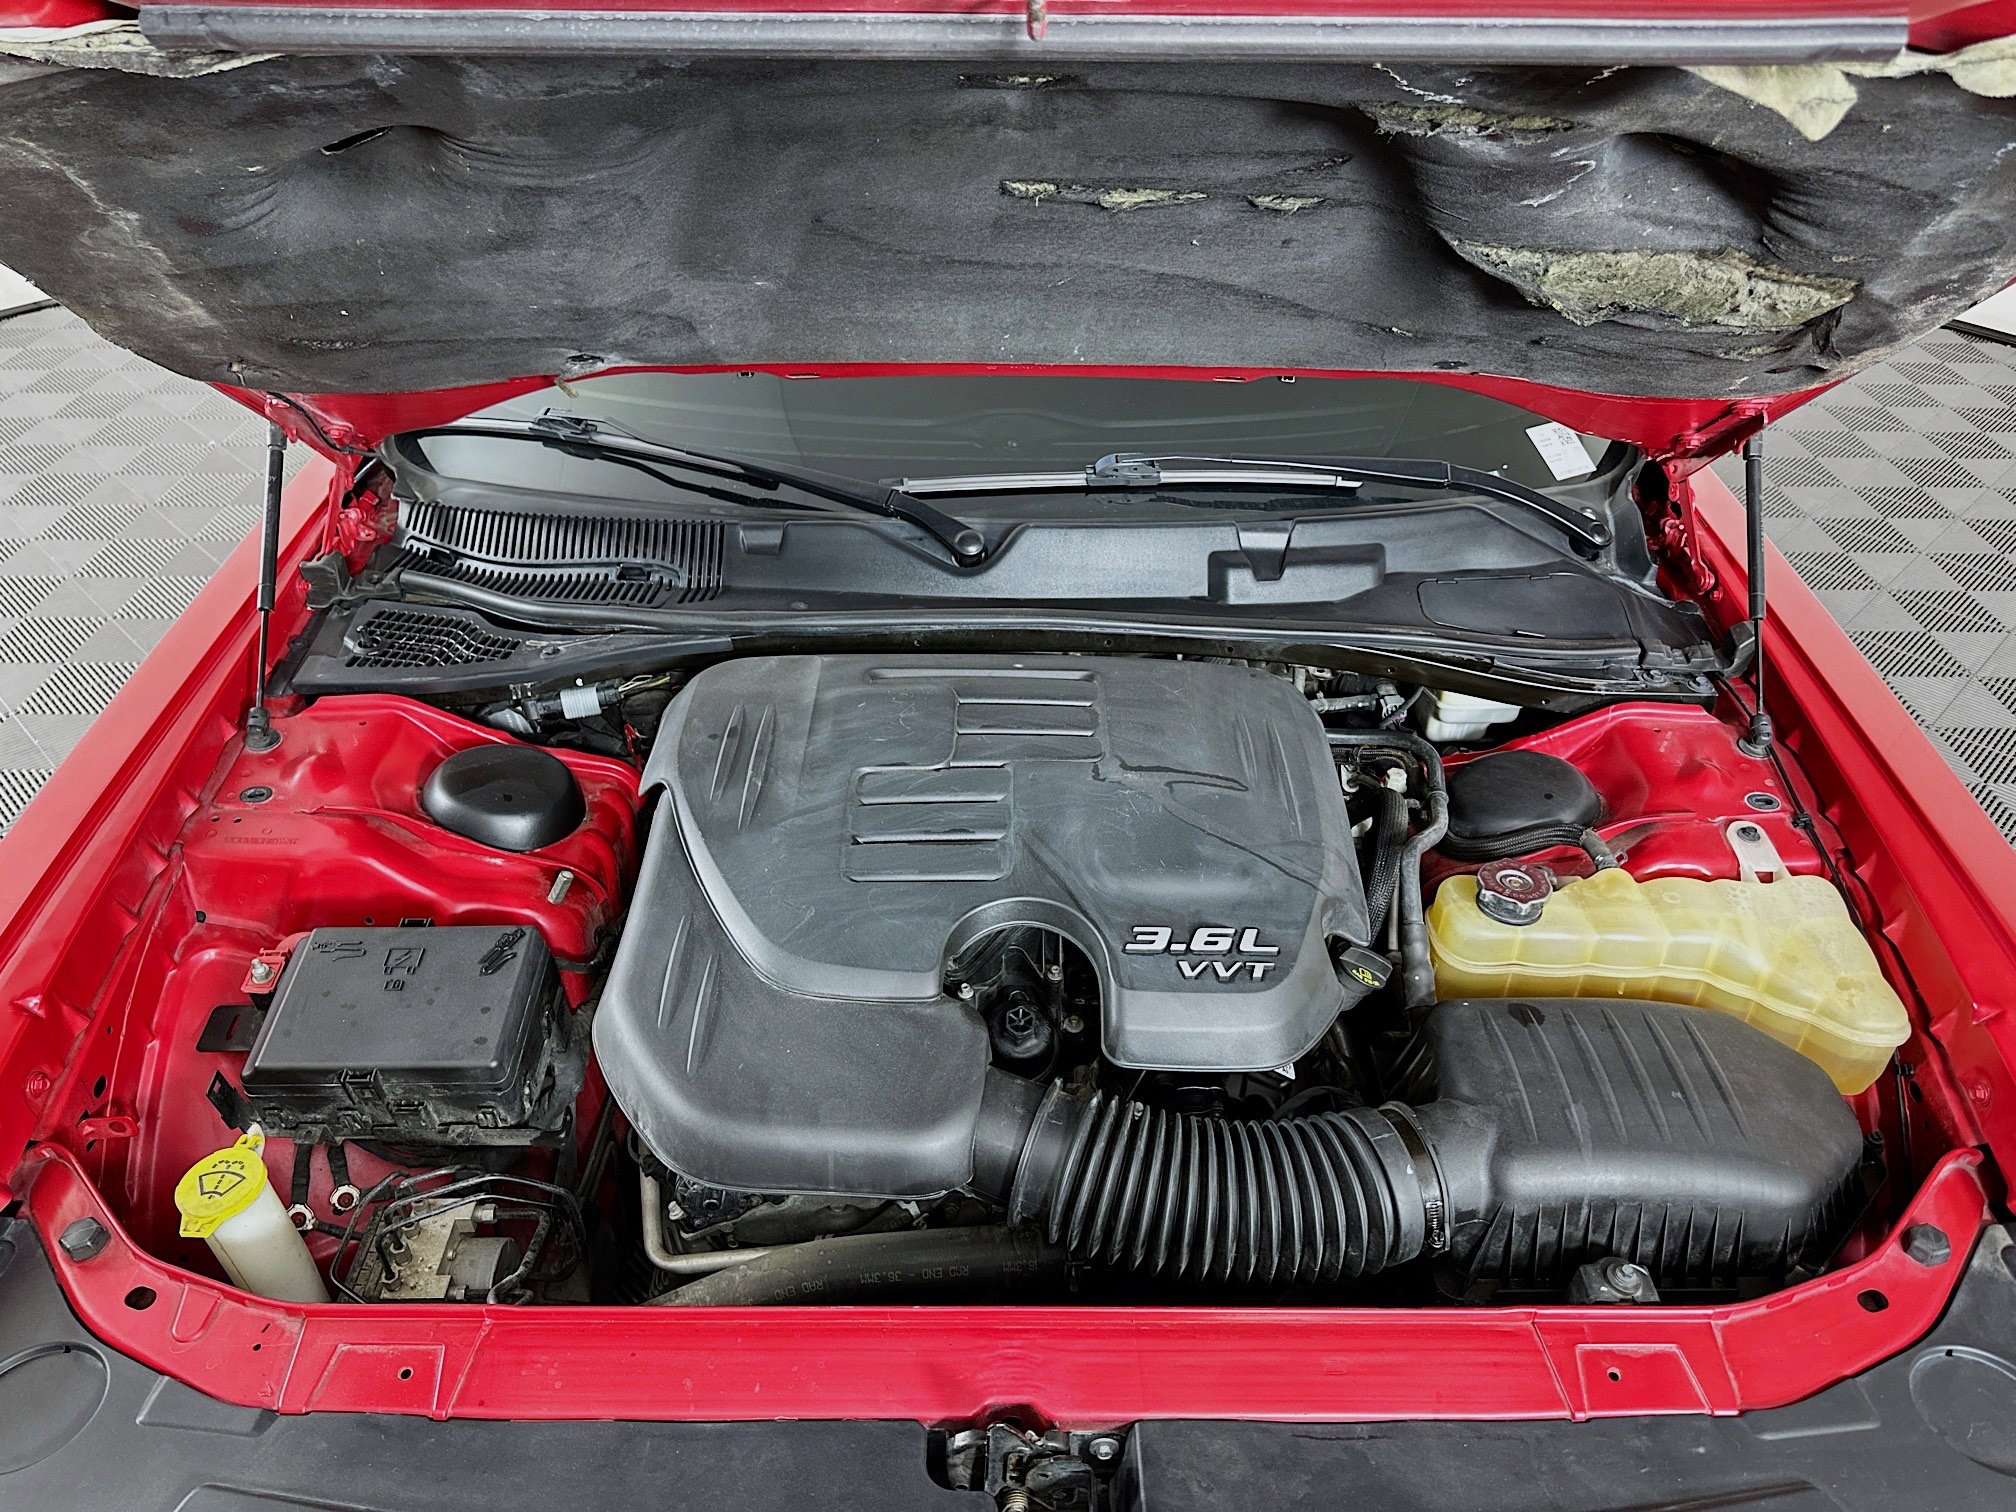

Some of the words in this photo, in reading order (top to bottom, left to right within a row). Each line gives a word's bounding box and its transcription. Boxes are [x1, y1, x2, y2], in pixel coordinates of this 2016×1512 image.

[1123, 926, 1280, 956] 3.6L
[1177, 960, 1275, 981] VVT
[860, 1270, 902, 1284] 36.3MM
[922, 1267, 943, 1279] END
[950, 1265, 969, 1277] RAD
[774, 1285, 797, 1300] END
[801, 1278, 825, 1293] RAD
